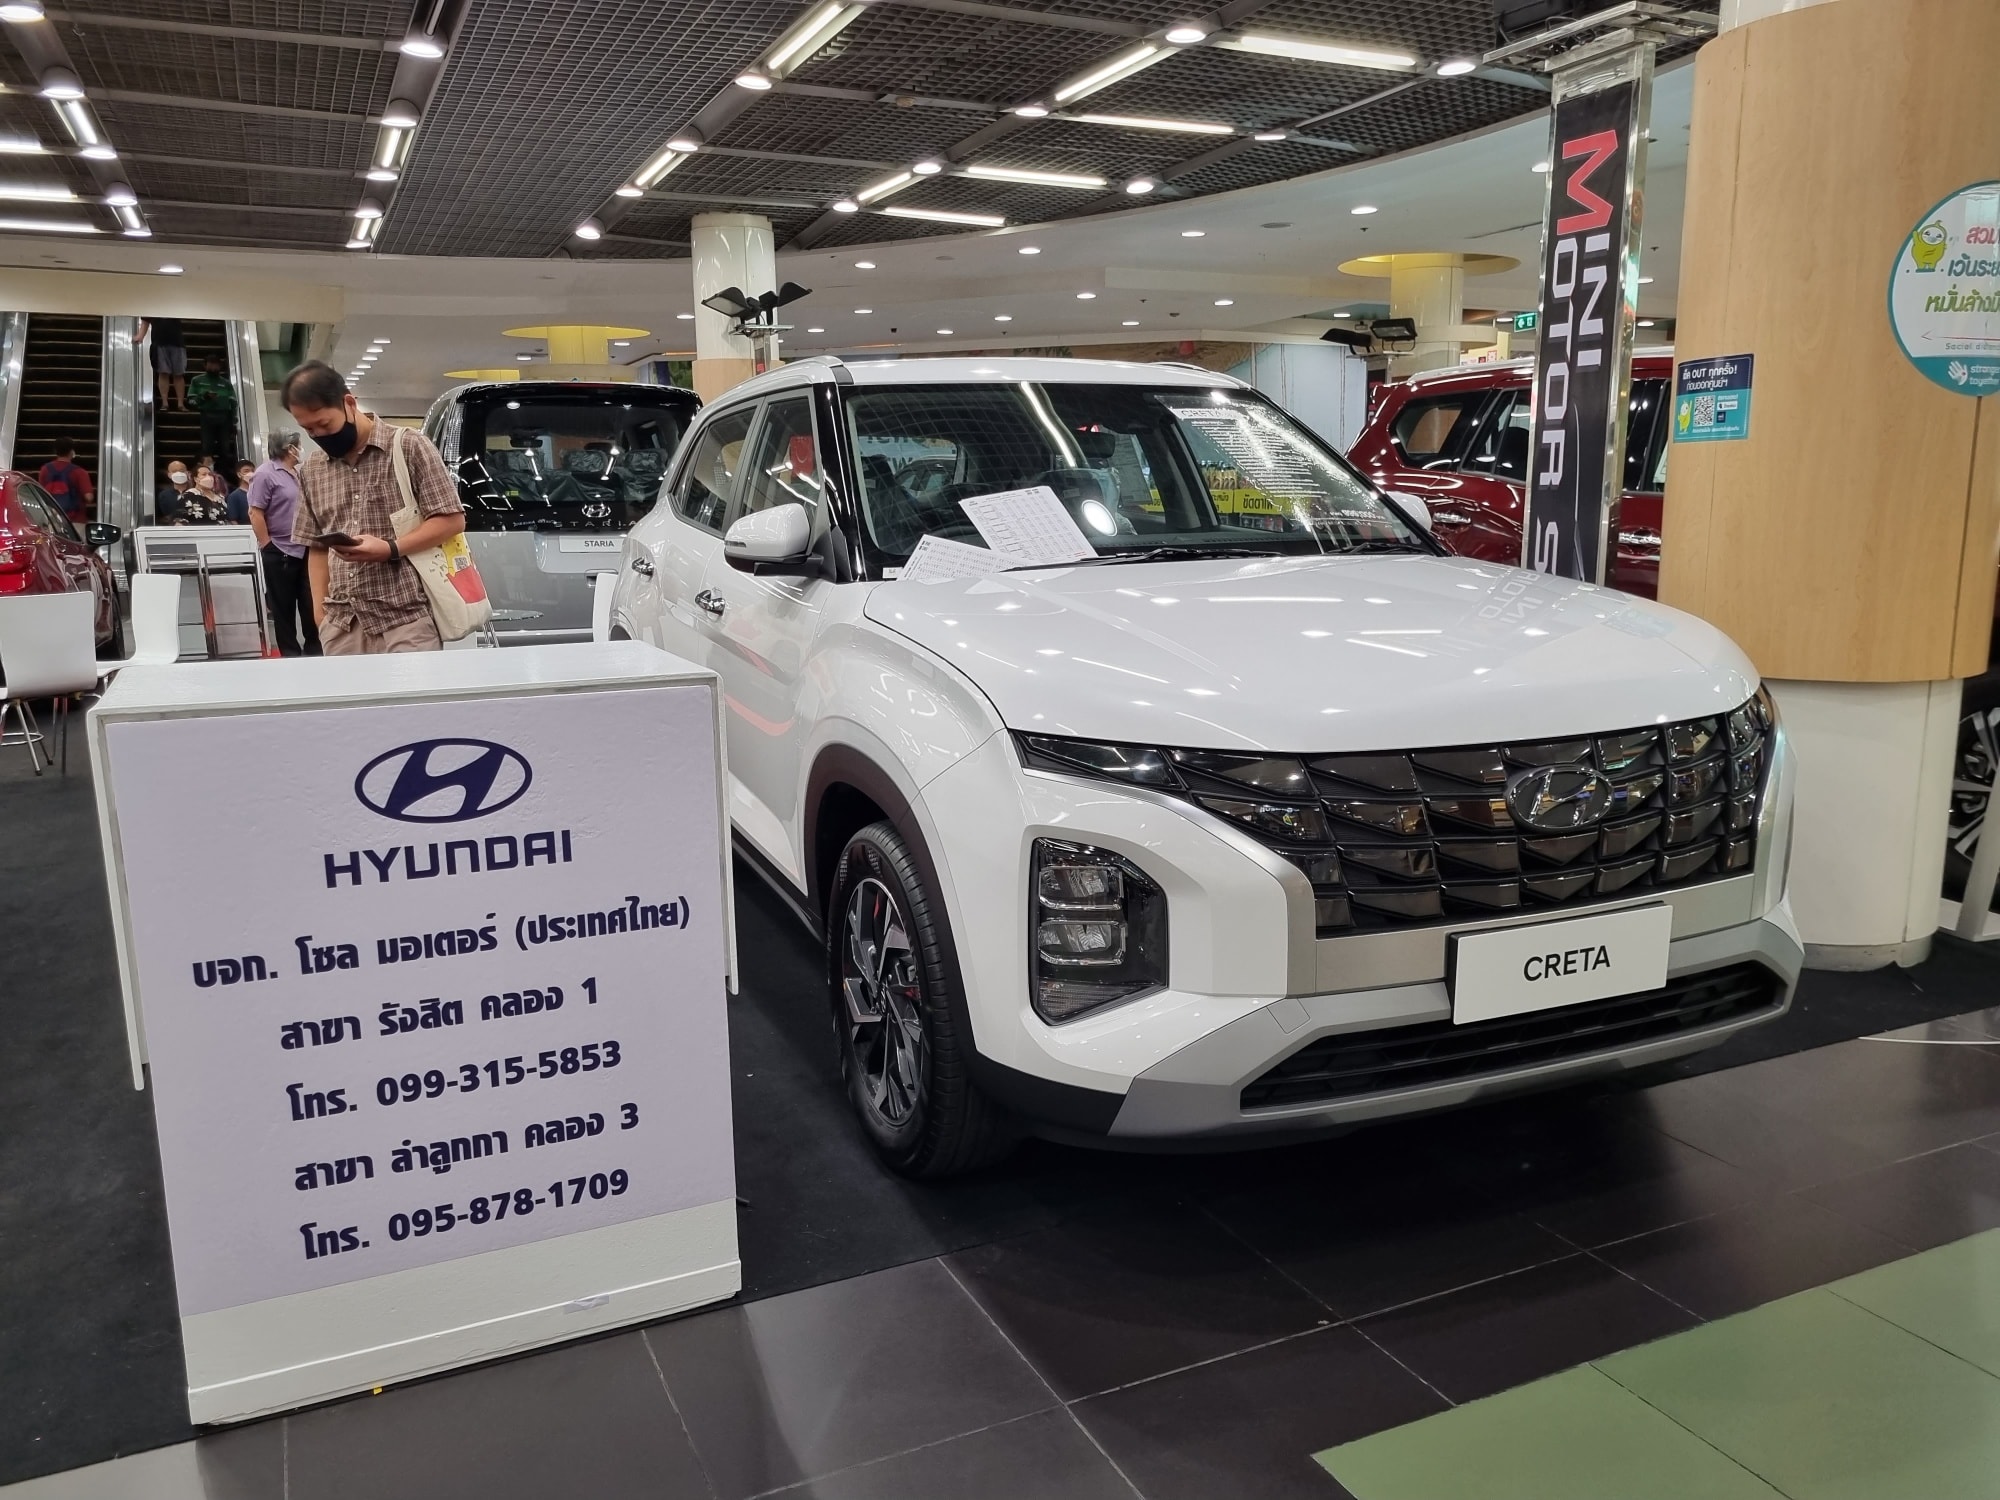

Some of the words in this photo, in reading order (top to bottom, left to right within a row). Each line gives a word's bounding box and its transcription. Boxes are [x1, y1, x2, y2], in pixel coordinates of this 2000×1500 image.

[1948, 253, 2000, 277] เว้นระย
[1692, 368, 1707, 378] OUT
[584, 540, 615, 548] STARIA
[1534, 516, 1558, 576] S
[324, 830, 572, 888] HYUNDAI
[193, 956, 277, 987] บจก.
[295, 936, 359, 974] โซล
[377, 913, 497, 964] มอเตอร์
[516, 896, 689, 950] (ประเทศไทย)
[1524, 945, 1611, 982] CRETA
[281, 1016, 361, 1049] สาขา
[379, 998, 463, 1035] รังสิต
[481, 987, 563, 1020] คลอง
[582, 977, 596, 1004] 1
[286, 1083, 357, 1121] โทร.
[377, 1041, 620, 1105] 099-315-5853
[295, 1156, 373, 1190] สาขา
[392, 1131, 508, 1174] ลำลูกกา
[525, 1113, 604, 1148] คลอง
[621, 1103, 638, 1129] 3
[300, 1222, 369, 1259] โทร.
[389, 1169, 628, 1241] 095-878-1709
